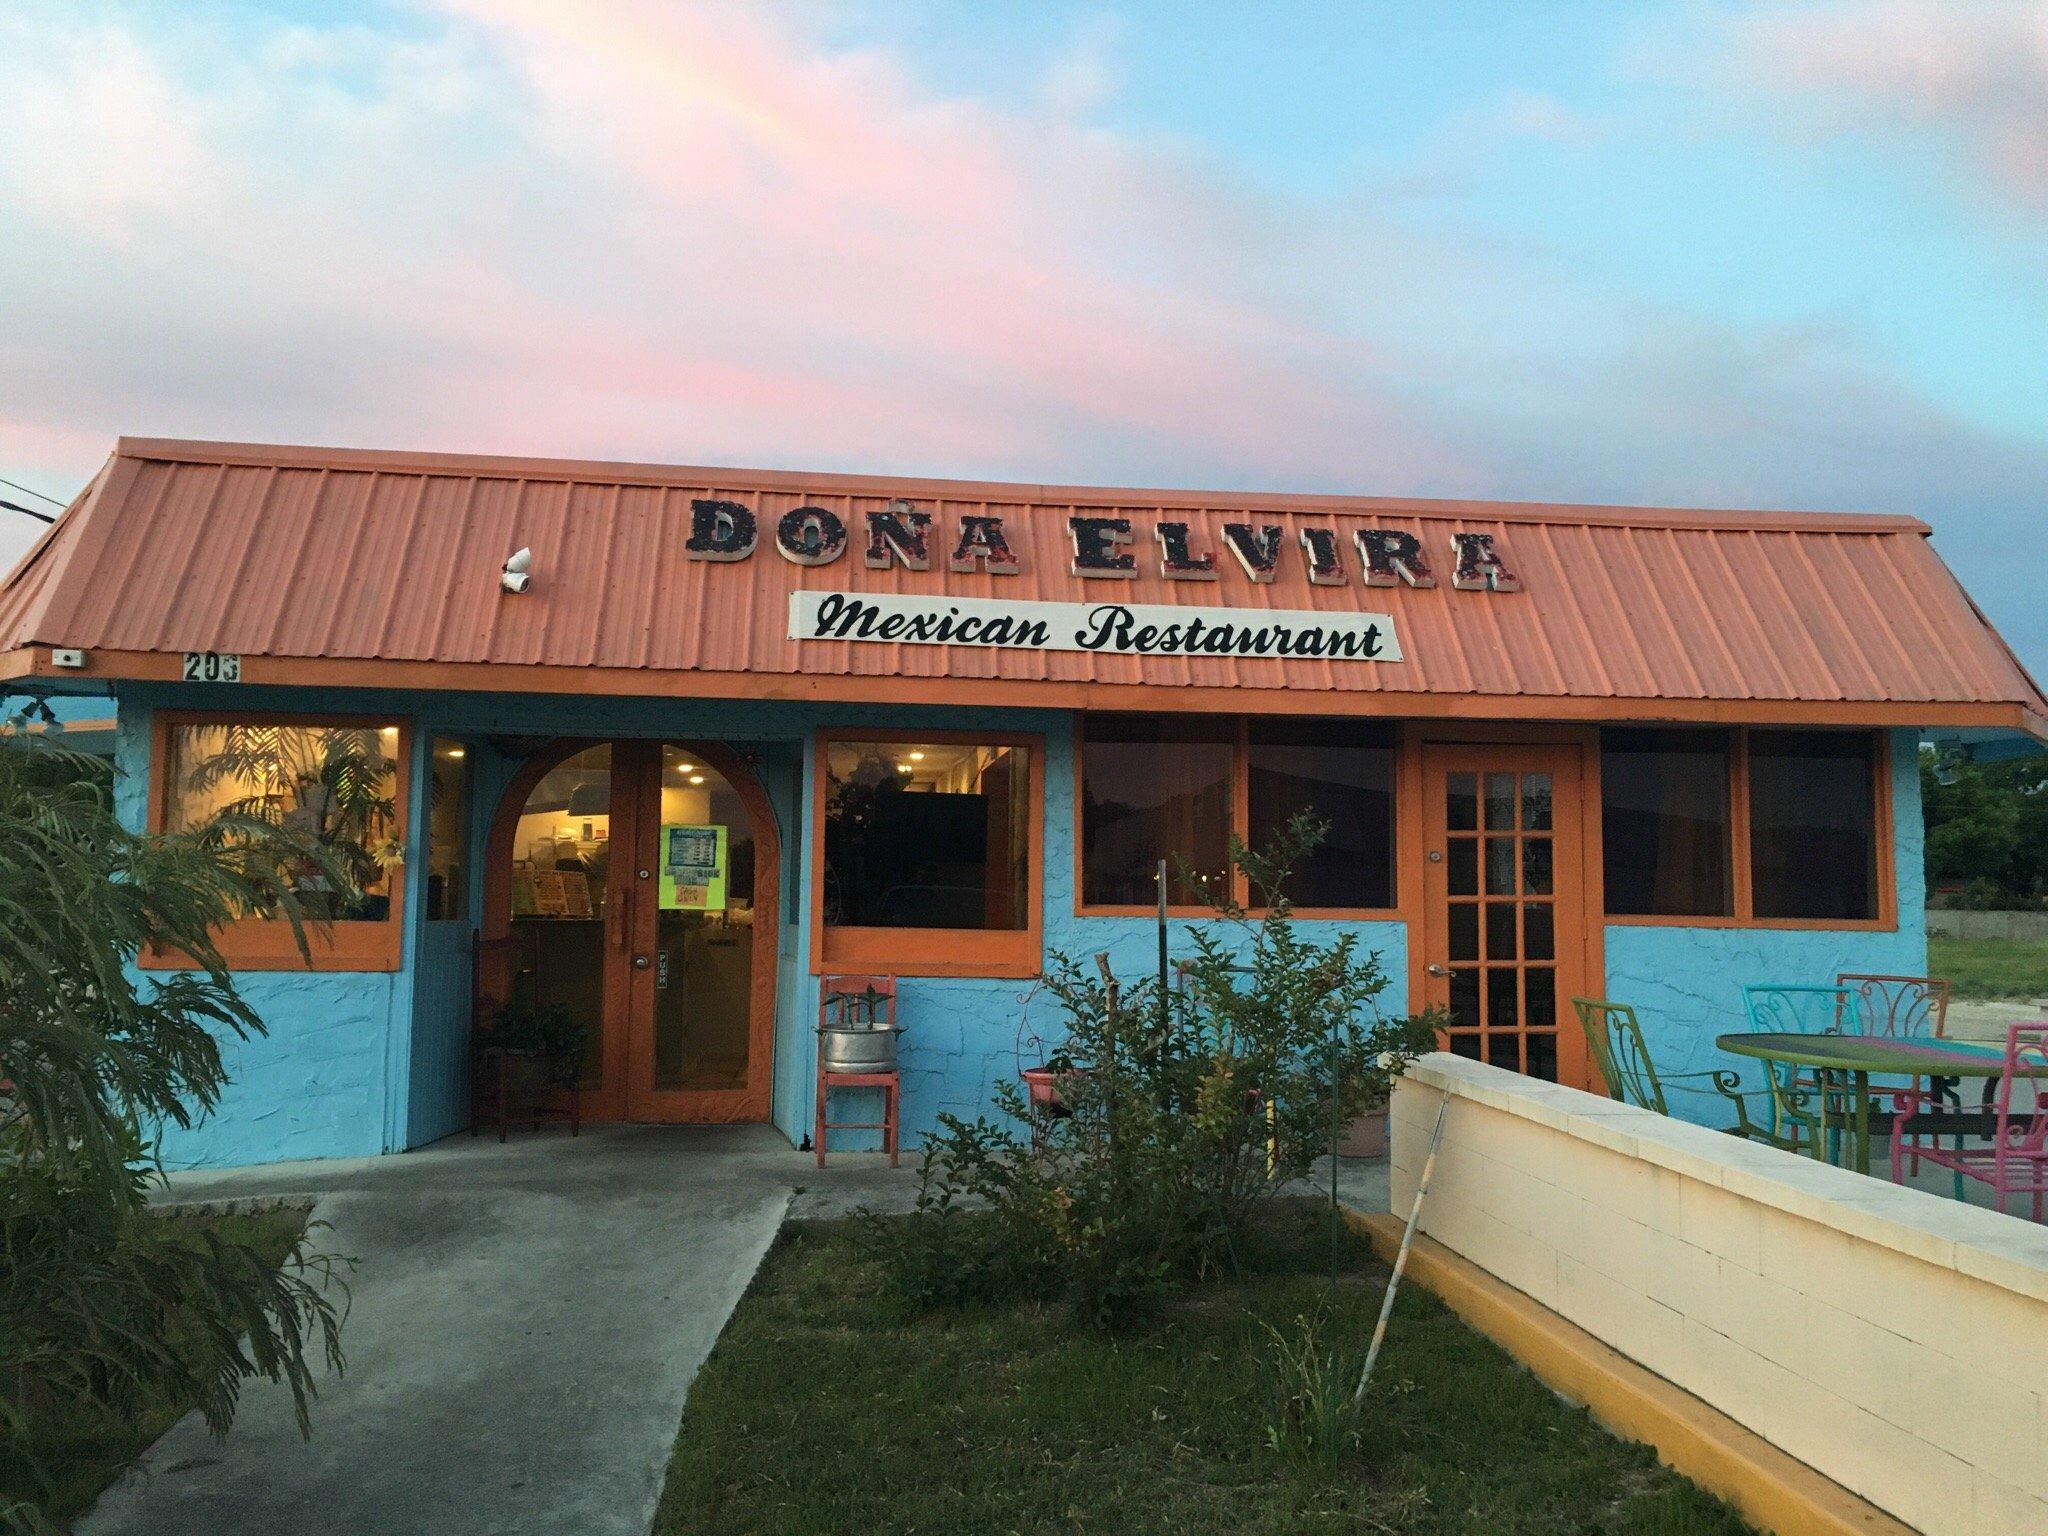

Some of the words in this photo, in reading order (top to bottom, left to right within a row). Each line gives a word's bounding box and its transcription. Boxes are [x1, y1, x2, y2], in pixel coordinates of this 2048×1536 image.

[1067, 517, 1520, 592] ELVIRA
[814, 593, 1051, 646] Mexican
[1075, 605, 1383, 658] Restaurant
